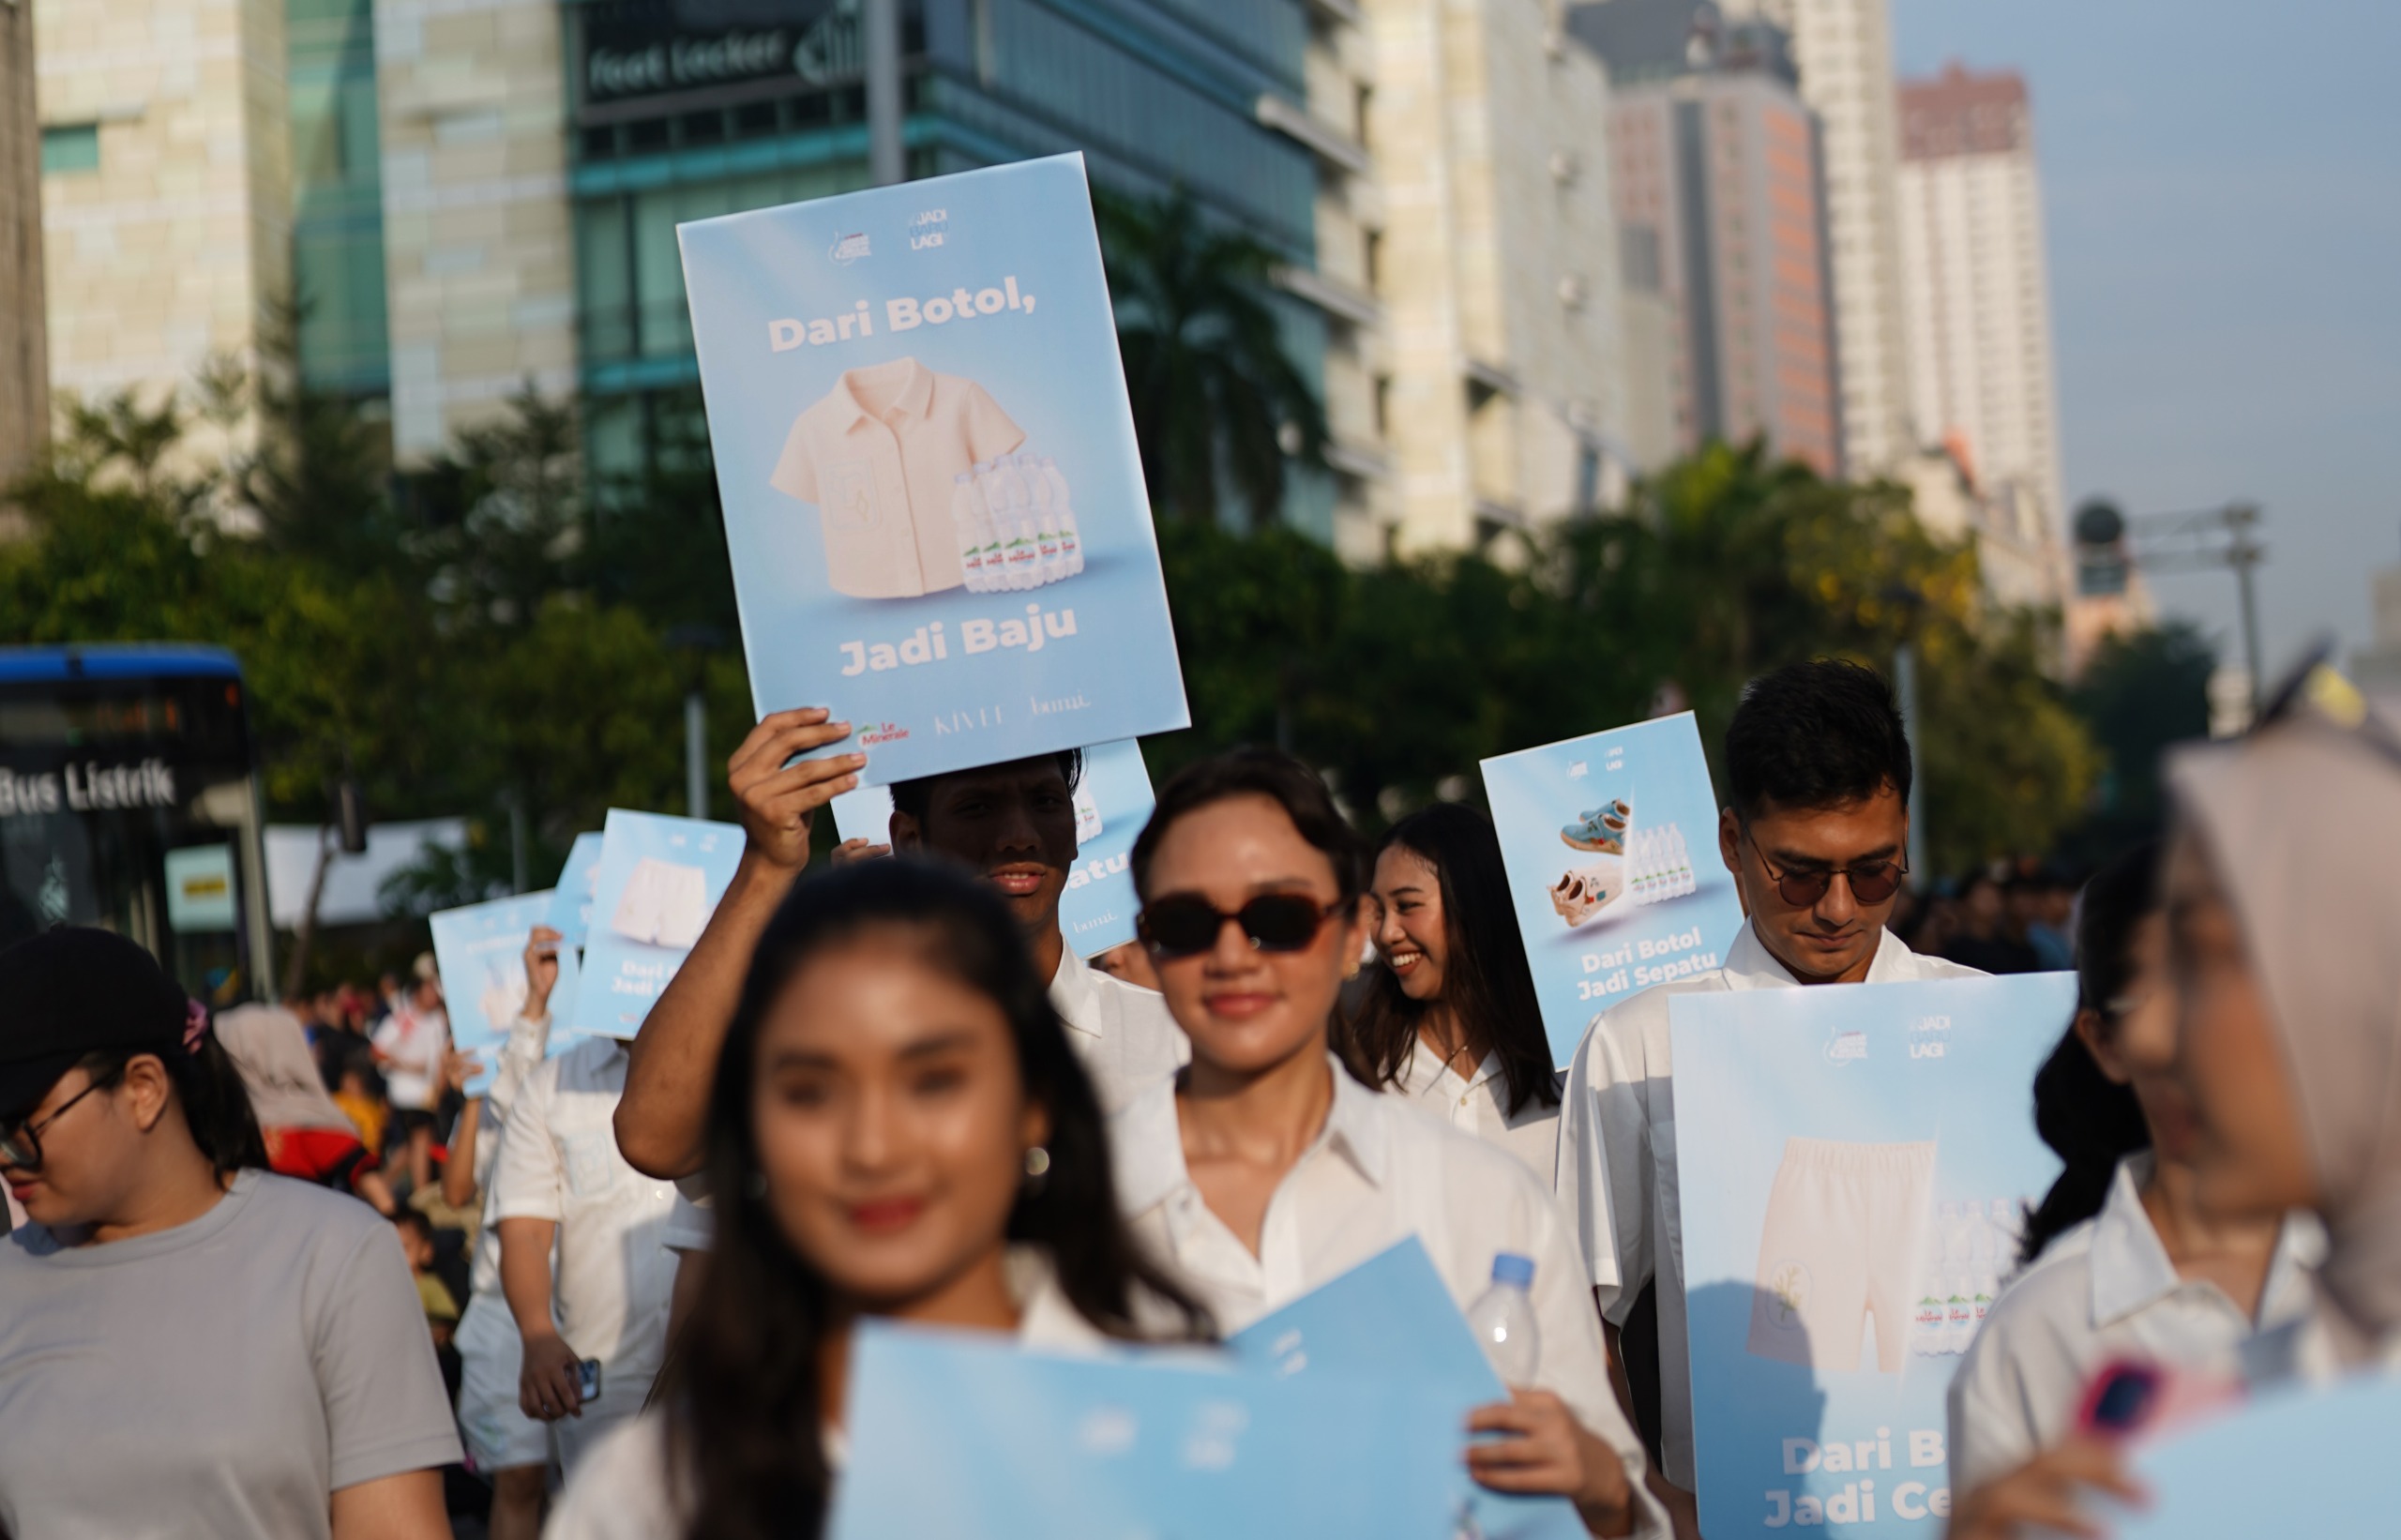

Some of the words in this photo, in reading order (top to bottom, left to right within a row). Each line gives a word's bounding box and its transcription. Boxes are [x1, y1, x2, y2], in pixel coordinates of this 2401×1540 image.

[910, 232, 944, 250] LAGI
[768, 299, 873, 353] Dari
[886, 276, 1036, 332] Botol,
[839, 621, 947, 676] Jadi
[960, 603, 1079, 654] Baju
[861, 728, 910, 747] Minerale
[881, 721, 896, 733] Le
[0, 765, 58, 816] Bus
[65, 757, 177, 811] Listrik
[1062, 852, 1130, 893] atu
[621, 959, 664, 979] Dari
[1581, 942, 1634, 974] Dari
[1638, 926, 1702, 959] Botol
[612, 975, 654, 997] Jadi
[1577, 968, 1630, 1001] Jadi
[1634, 952, 1717, 986] Sepatu
[1910, 1041, 1945, 1059] LAGI
[1782, 1426, 1892, 1475] Dari
[1763, 1479, 1876, 1528] Jadi
